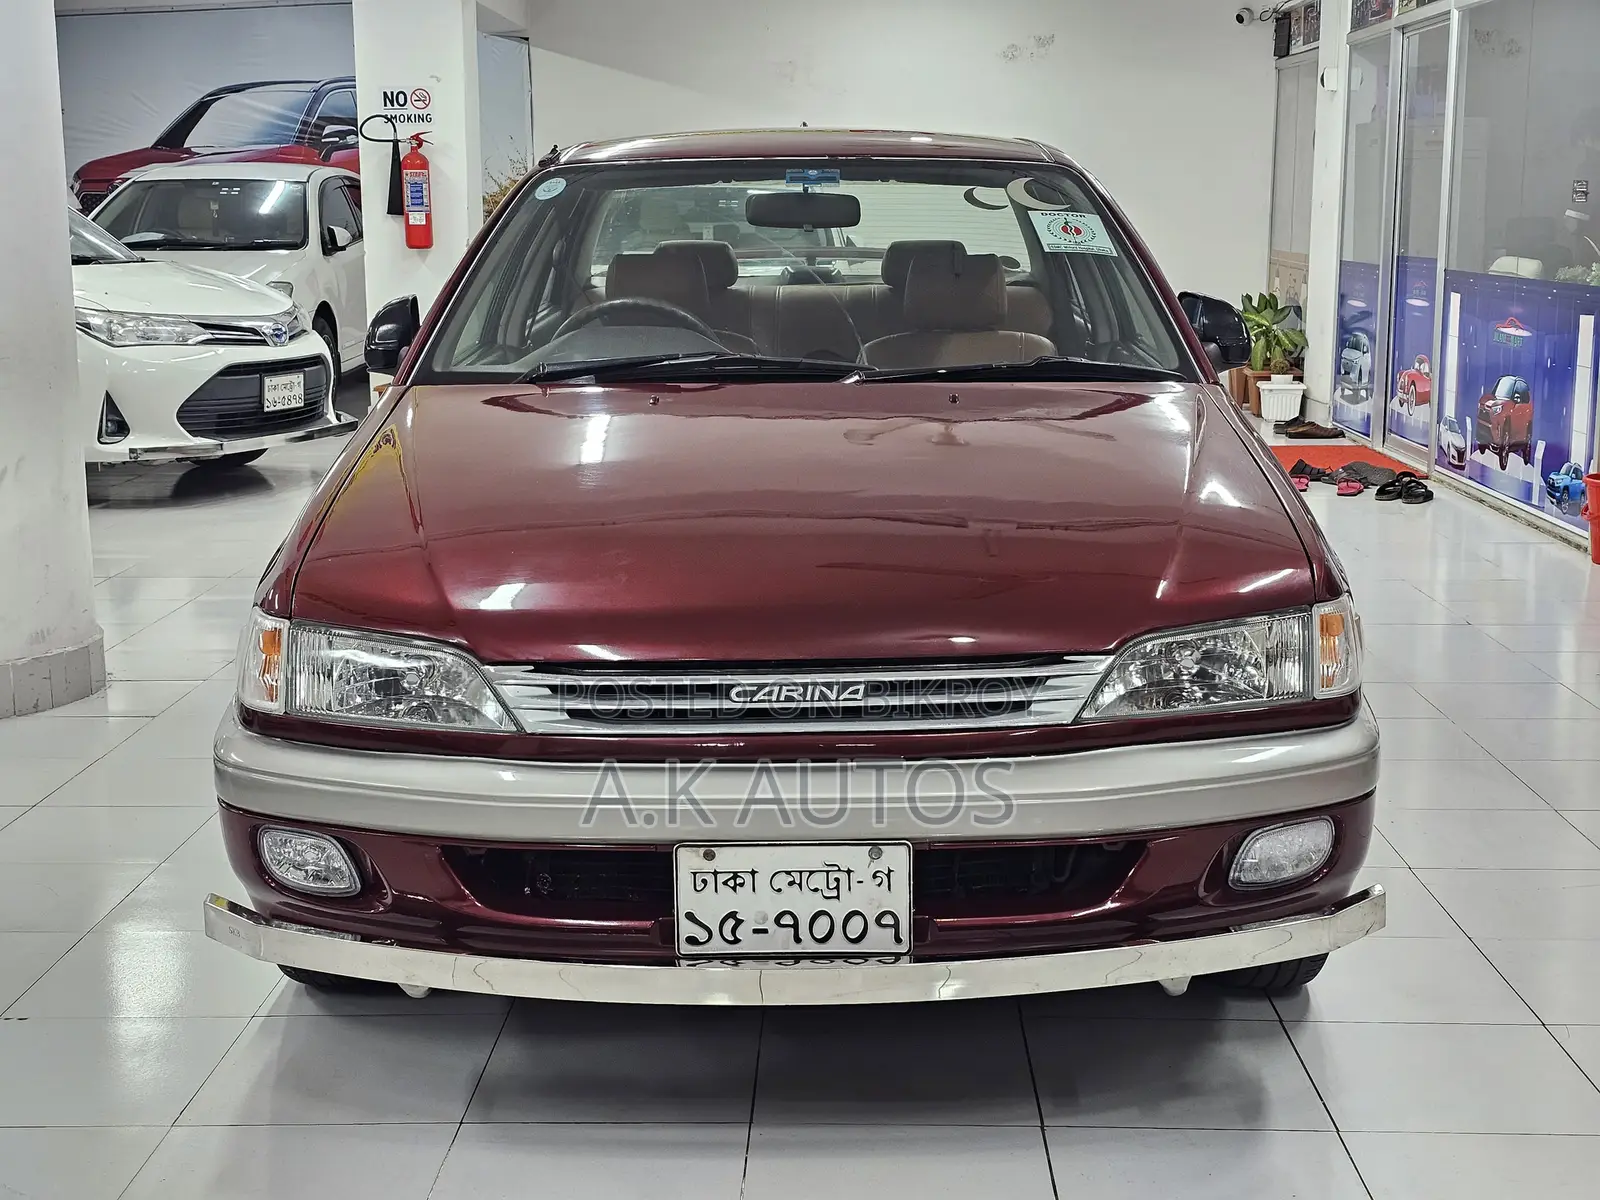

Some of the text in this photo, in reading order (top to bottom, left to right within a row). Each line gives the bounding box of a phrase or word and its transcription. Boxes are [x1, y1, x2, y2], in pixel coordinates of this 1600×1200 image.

[383, 91, 407, 107] NO
[384, 113, 433, 124] SMOKING
[728, 683, 868, 703] CARINA
[690, 868, 759, 894] ঢাকা
[684, 909, 904, 945] ১৫-৭০০৭
